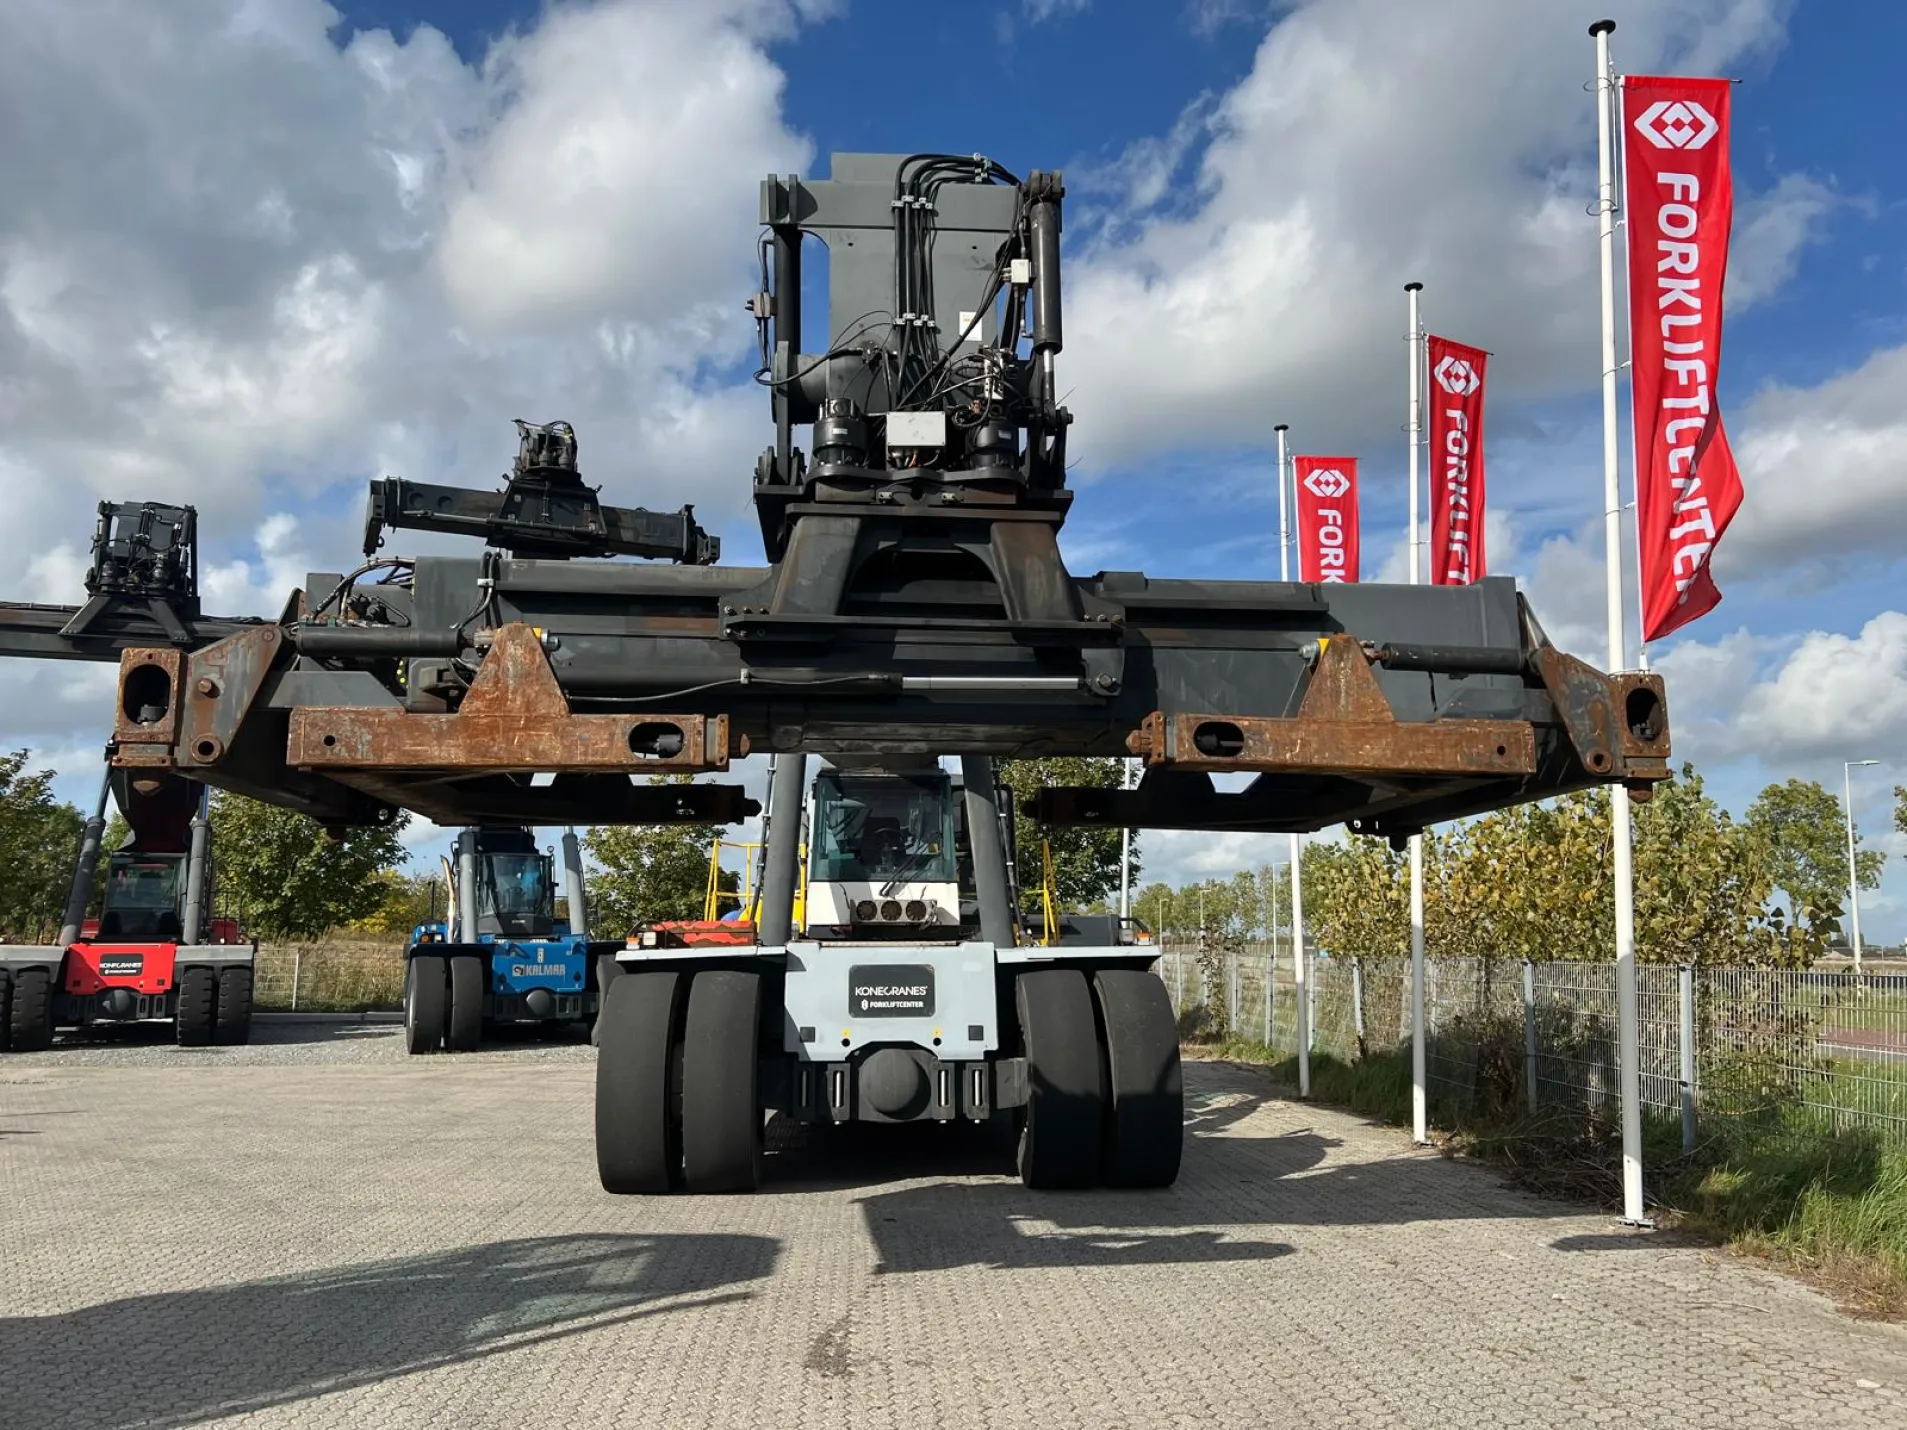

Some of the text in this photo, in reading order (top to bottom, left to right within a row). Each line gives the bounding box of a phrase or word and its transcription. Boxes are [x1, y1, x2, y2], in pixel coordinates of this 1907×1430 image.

[1317, 508, 1346, 583] FORK
[526, 964, 566, 976] KALMAR
[855, 986, 927, 996] KONECRANES
